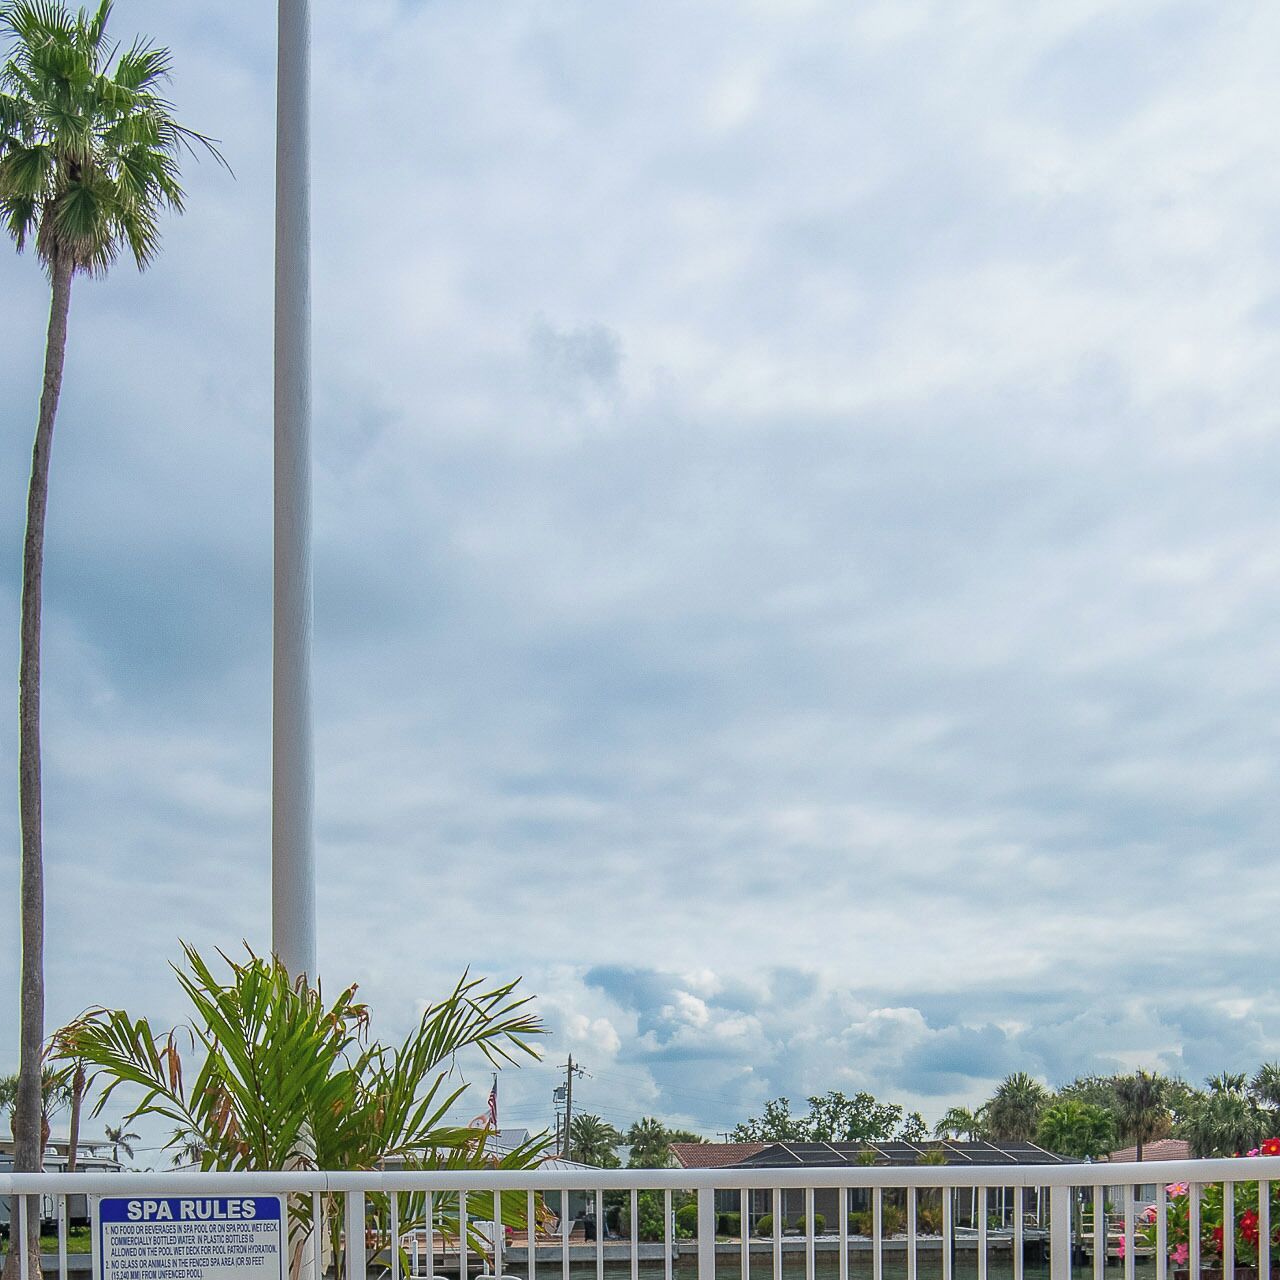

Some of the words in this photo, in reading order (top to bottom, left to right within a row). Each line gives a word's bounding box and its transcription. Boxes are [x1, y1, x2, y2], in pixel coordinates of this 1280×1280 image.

[128, 1201, 172, 1220] SPA
[181, 1200, 256, 1219] RULES
[111, 1226, 118, 1234] NO
[120, 1226, 134, 1234] FOOD
[136, 1226, 144, 1234] OR
[145, 1225, 176, 1234] BEVERAGES
[177, 1225, 182, 1233] IN
[184, 1225, 193, 1233] SPA
[194, 1225, 207, 1233] POOL
[209, 1224, 216, 1233] OR
[218, 1224, 225, 1232] ON
[226, 1224, 236, 1232] SPA
[237, 1224, 250, 1232] POOL
[252, 1224, 262, 1232] WET
[111, 1237, 152, 1246] COMMERCIALLY
[153, 1236, 176, 1245] BOTTLED
[178, 1236, 195, 1244] WATER
[198, 1236, 202, 1244] IN
[204, 1235, 224, 1244] PLASTIC
[226, 1235, 248, 1243] BOTTLES
[249, 1235, 254, 1243] IS
[111, 1248, 137, 1256] ALLOWED
[138, 1247, 146, 1256] ON
[147, 1247, 157, 1256] THE
[158, 1247, 172, 1255] POOL
[174, 1247, 184, 1255] WET
[186, 1246, 199, 1255] DECK
[201, 1246, 211, 1254] FOR
[212, 1246, 226, 1254] POOL
[227, 1246, 246, 1254] PATRON
[112, 1261, 119, 1269] NO
[120, 1260, 138, 1269] GLASS
[140, 1260, 147, 1268] OR
[148, 1259, 171, 1268] ANIMALS
[173, 1259, 177, 1267] IN
[179, 1259, 188, 1267] THE
[189, 1258, 209, 1267] FENCED
[211, 1258, 220, 1266] SPA
[221, 1258, 234, 1266] AREA
[246, 1257, 251, 1265] 50
[252, 1257, 264, 1265] FEET
[142, 1271, 156, 1280] FROM
[158, 1270, 185, 1280] UNFENCED
